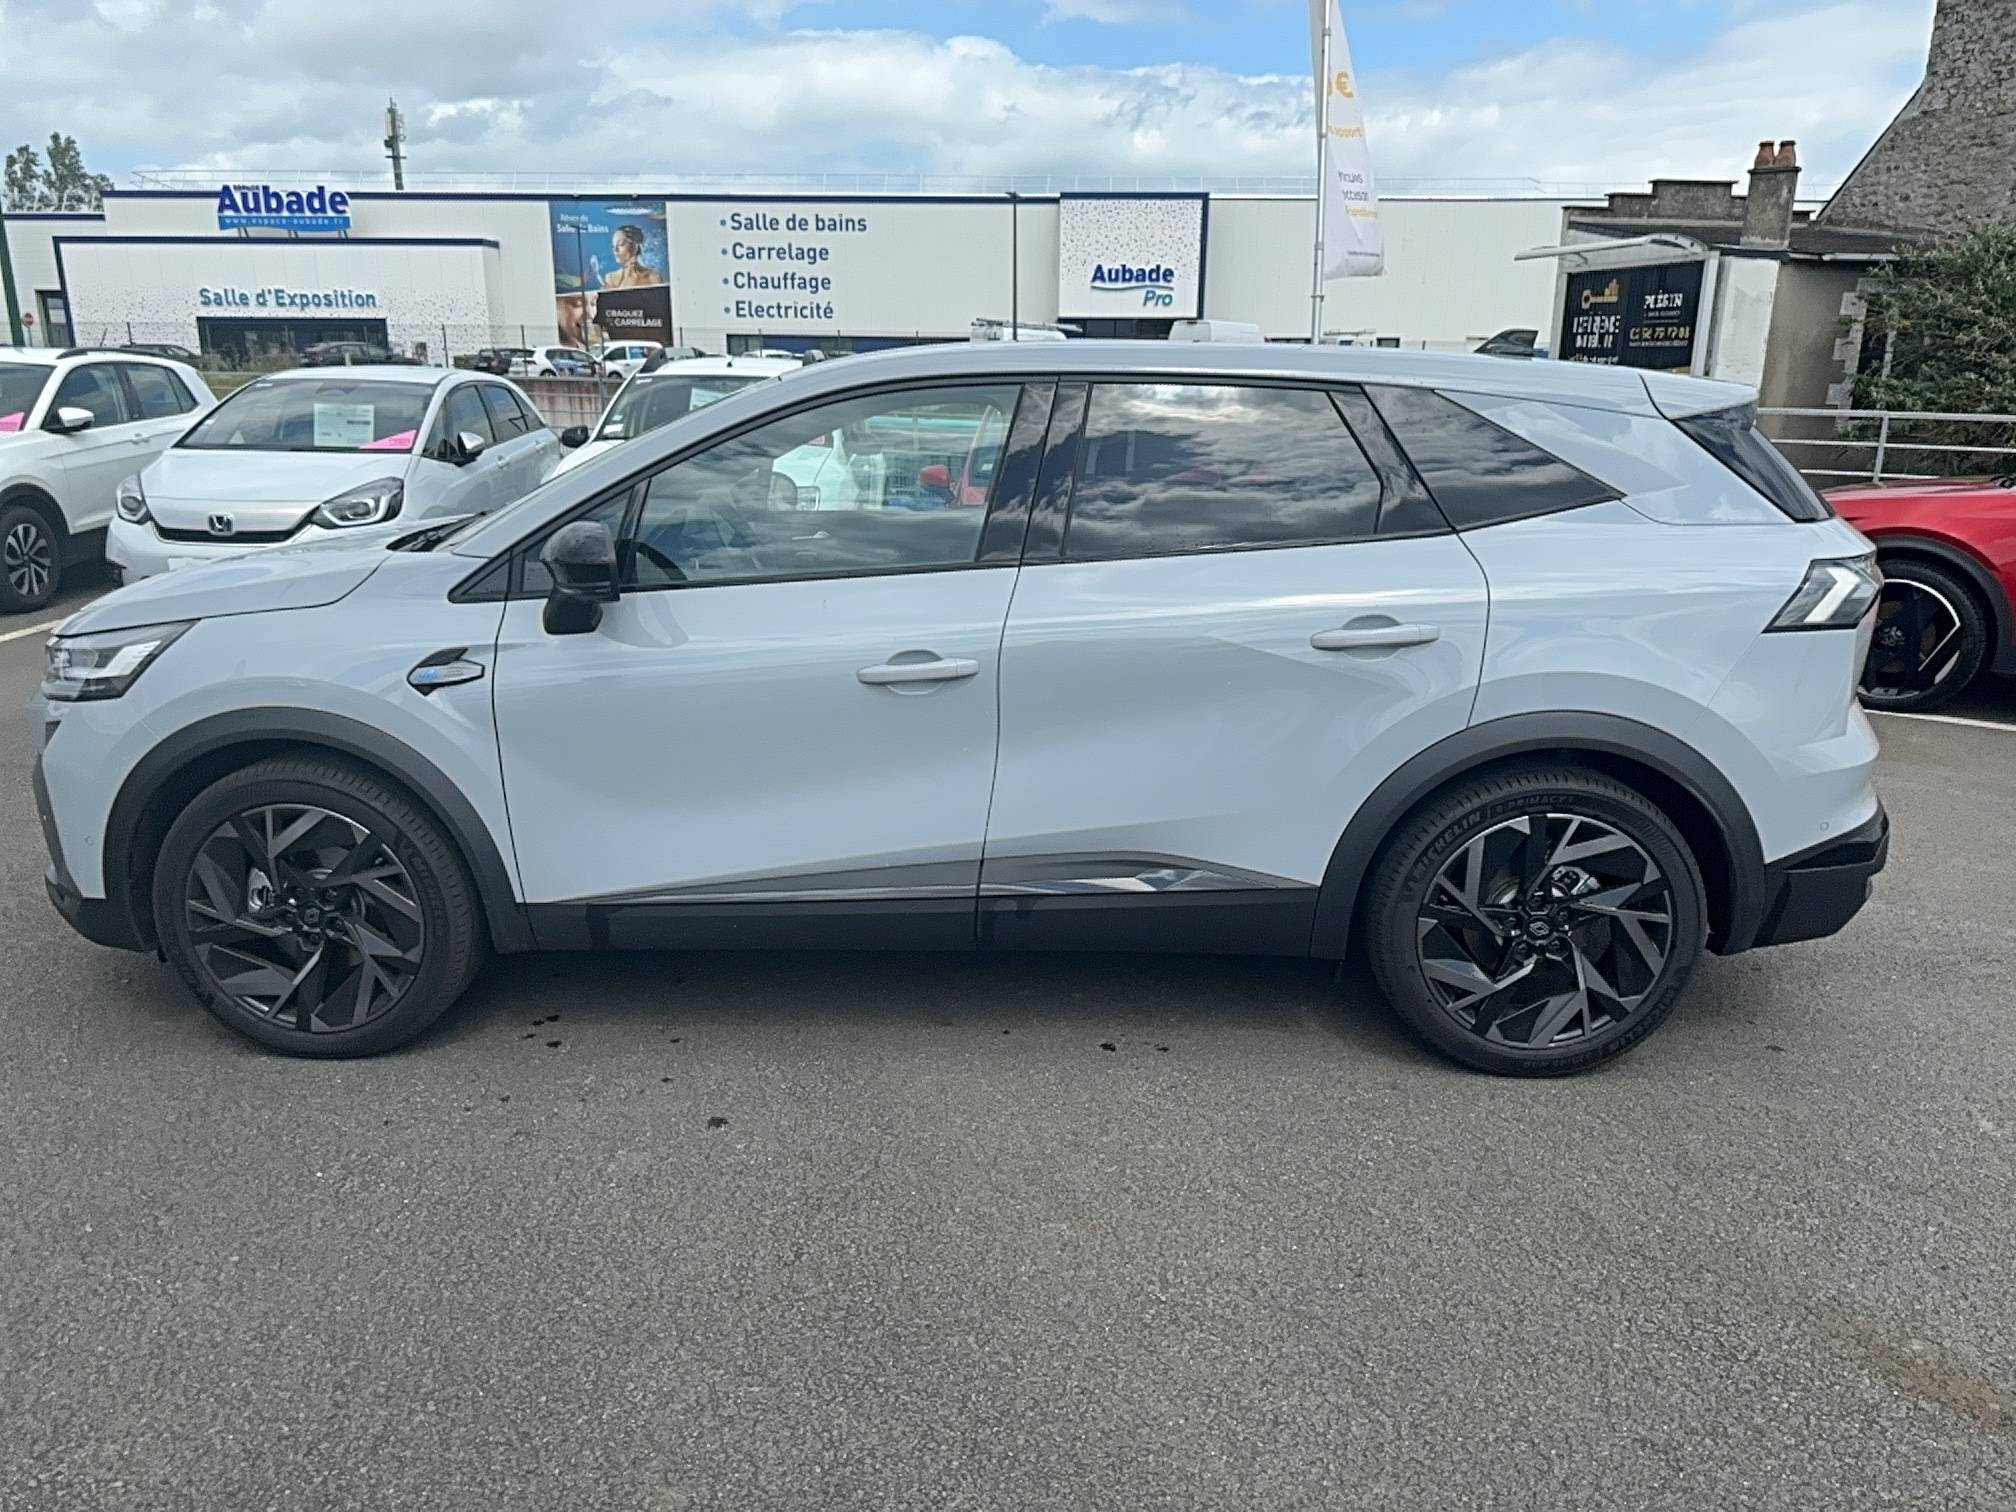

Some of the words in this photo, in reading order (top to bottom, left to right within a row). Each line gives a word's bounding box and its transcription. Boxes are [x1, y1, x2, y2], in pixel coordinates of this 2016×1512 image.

[217, 185, 349, 214] Aubade
[588, 224, 609, 233] Bains
[731, 213, 780, 231] Salle
[785, 213, 809, 231] de
[815, 213, 868, 232] bains
[732, 242, 830, 265] Carrelage
[733, 271, 832, 294] Chauffage
[1090, 263, 1175, 283] Aubade
[199, 288, 250, 306] Salle
[256, 289, 377, 310] d'Exposition
[1143, 290, 1173, 307] Pro
[735, 300, 834, 319] Electricité
[614, 318, 664, 328] CARRELAGE
[1410, 810, 1482, 879] MICHELIN
